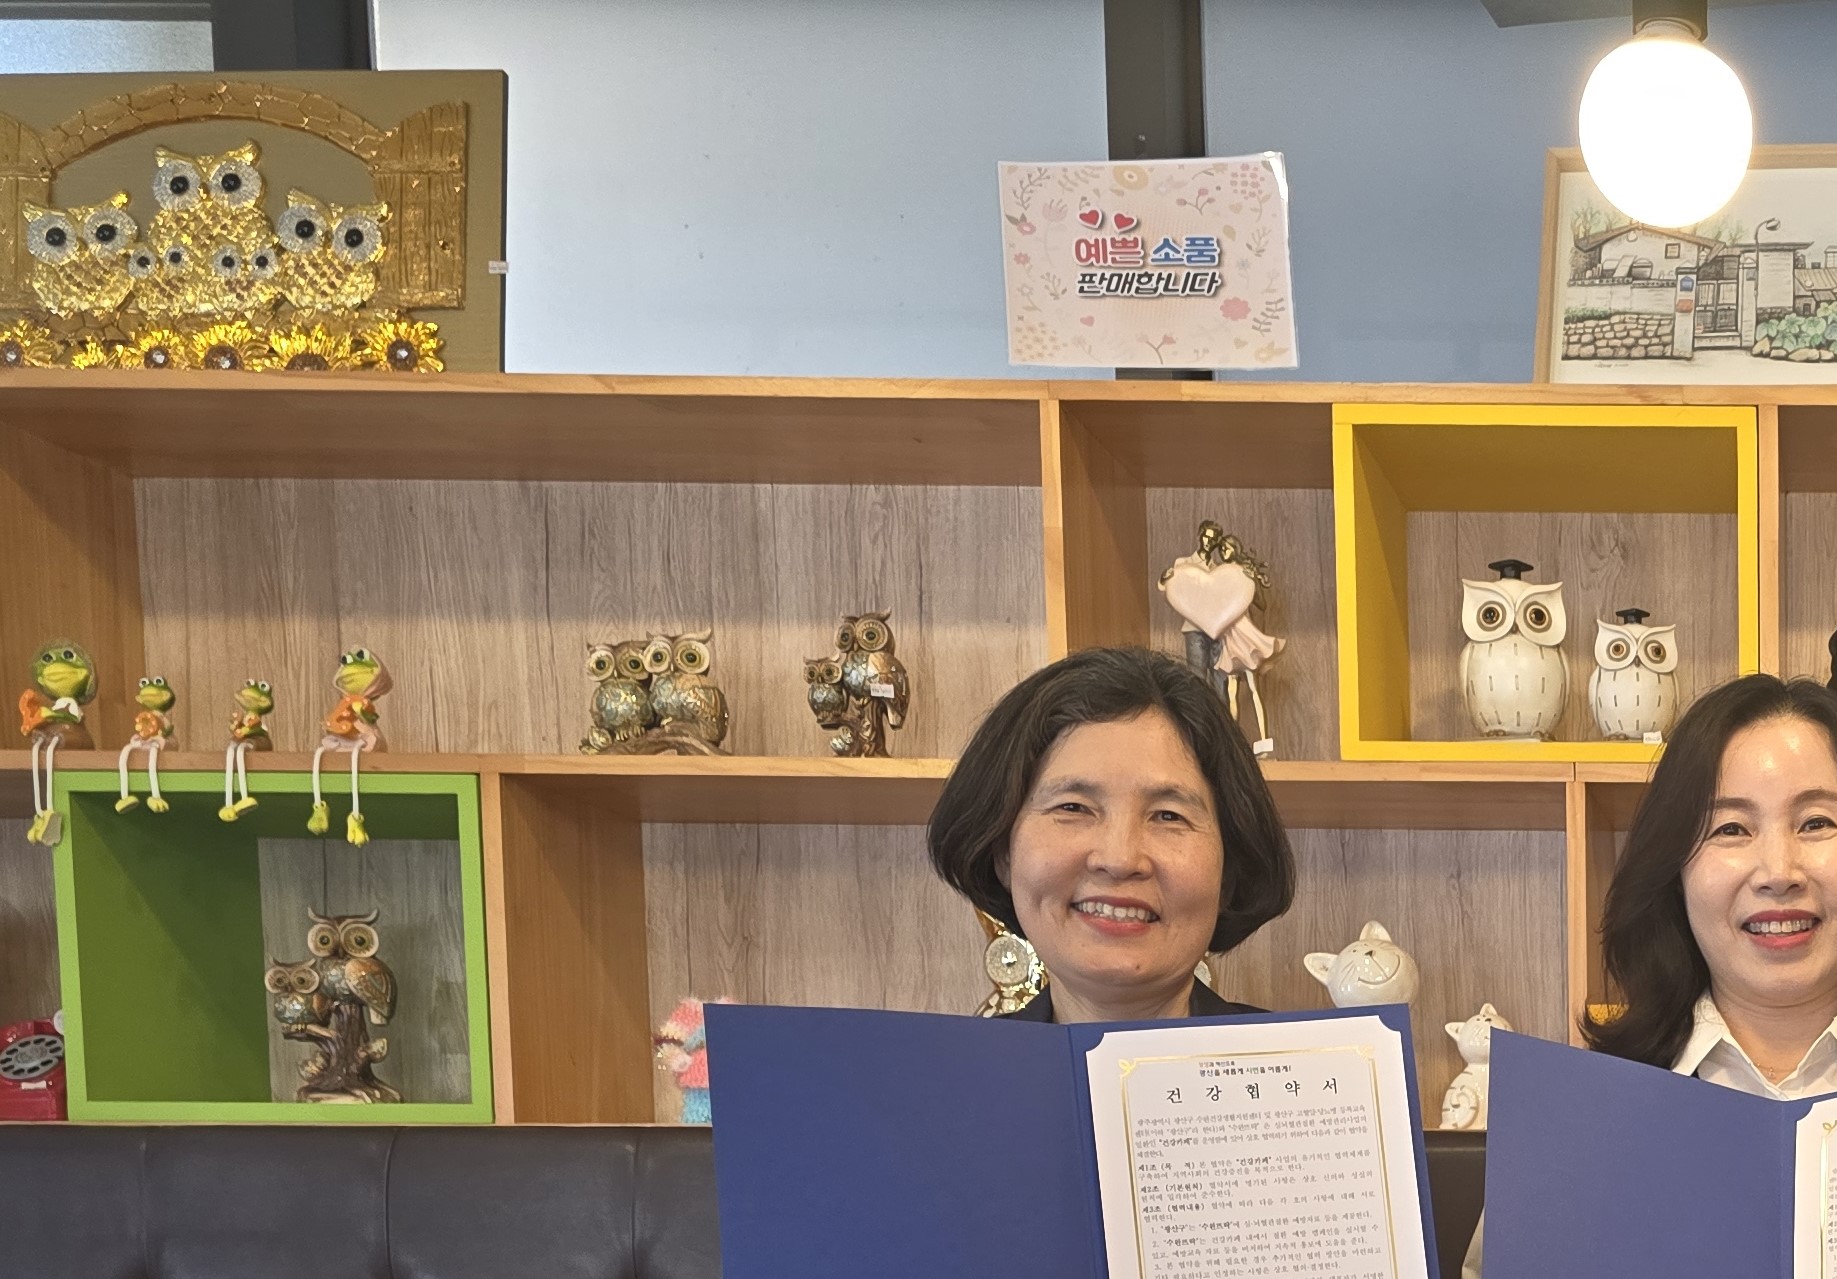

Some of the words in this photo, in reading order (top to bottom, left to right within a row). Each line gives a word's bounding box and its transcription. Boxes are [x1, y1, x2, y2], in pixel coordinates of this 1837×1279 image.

[1075, 237, 1142, 265] 예쁜
[1150, 237, 1219, 264] 소품
[1078, 272, 1220, 295] 판매합니다
